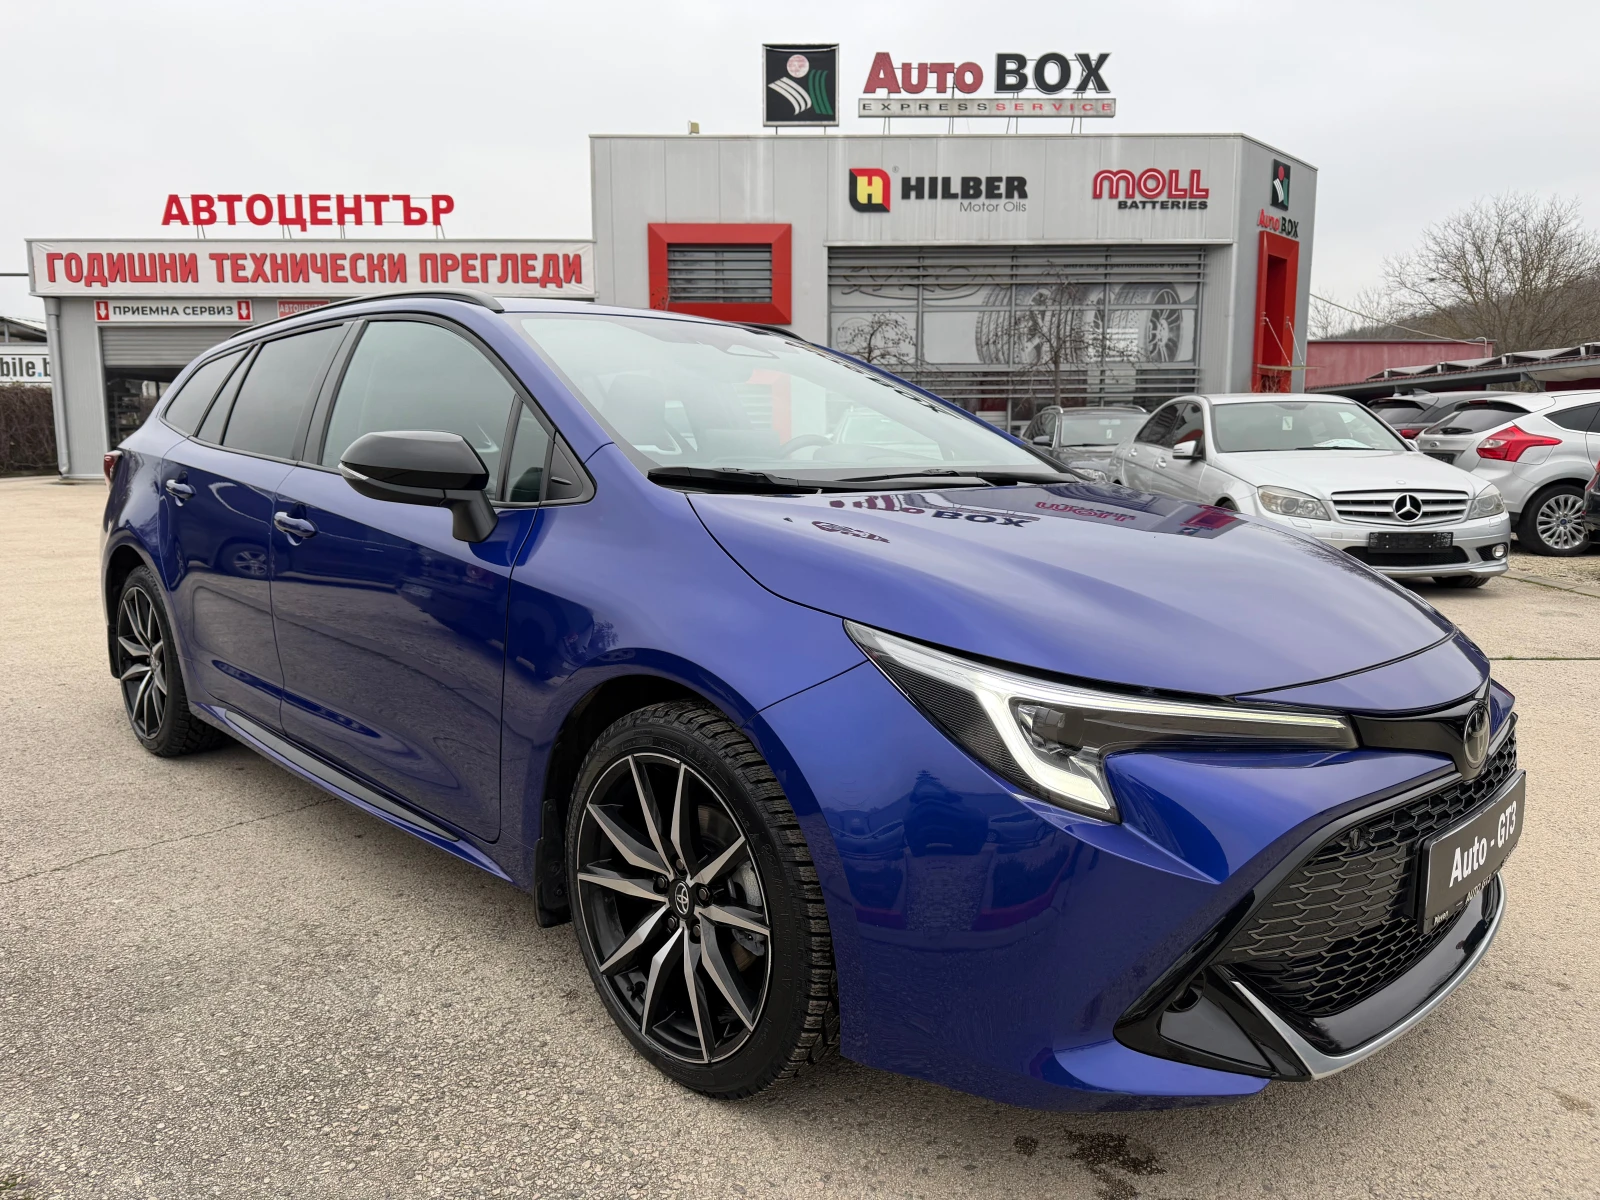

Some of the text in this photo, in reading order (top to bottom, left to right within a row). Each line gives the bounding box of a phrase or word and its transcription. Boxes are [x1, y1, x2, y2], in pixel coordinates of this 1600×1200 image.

[864, 52, 1111, 93] AUTO BOX
[902, 177, 1028, 199] HILBER
[161, 194, 454, 232] АВТОЦЕНТЪР
[959, 197, 1028, 212] Motor Oils
[1117, 200, 1208, 210] BATTERIES
[1281, 216, 1299, 238] BOX
[47, 253, 582, 288] ГОДИШНИ ТЕХНИЧЕСКИ ПРЕГЛЕДИ
[112, 305, 234, 316] ПРИЕМНА СЕРВИЗ
[1449, 835, 1487, 888] Auto
[1498, 800, 1517, 849] GT3
